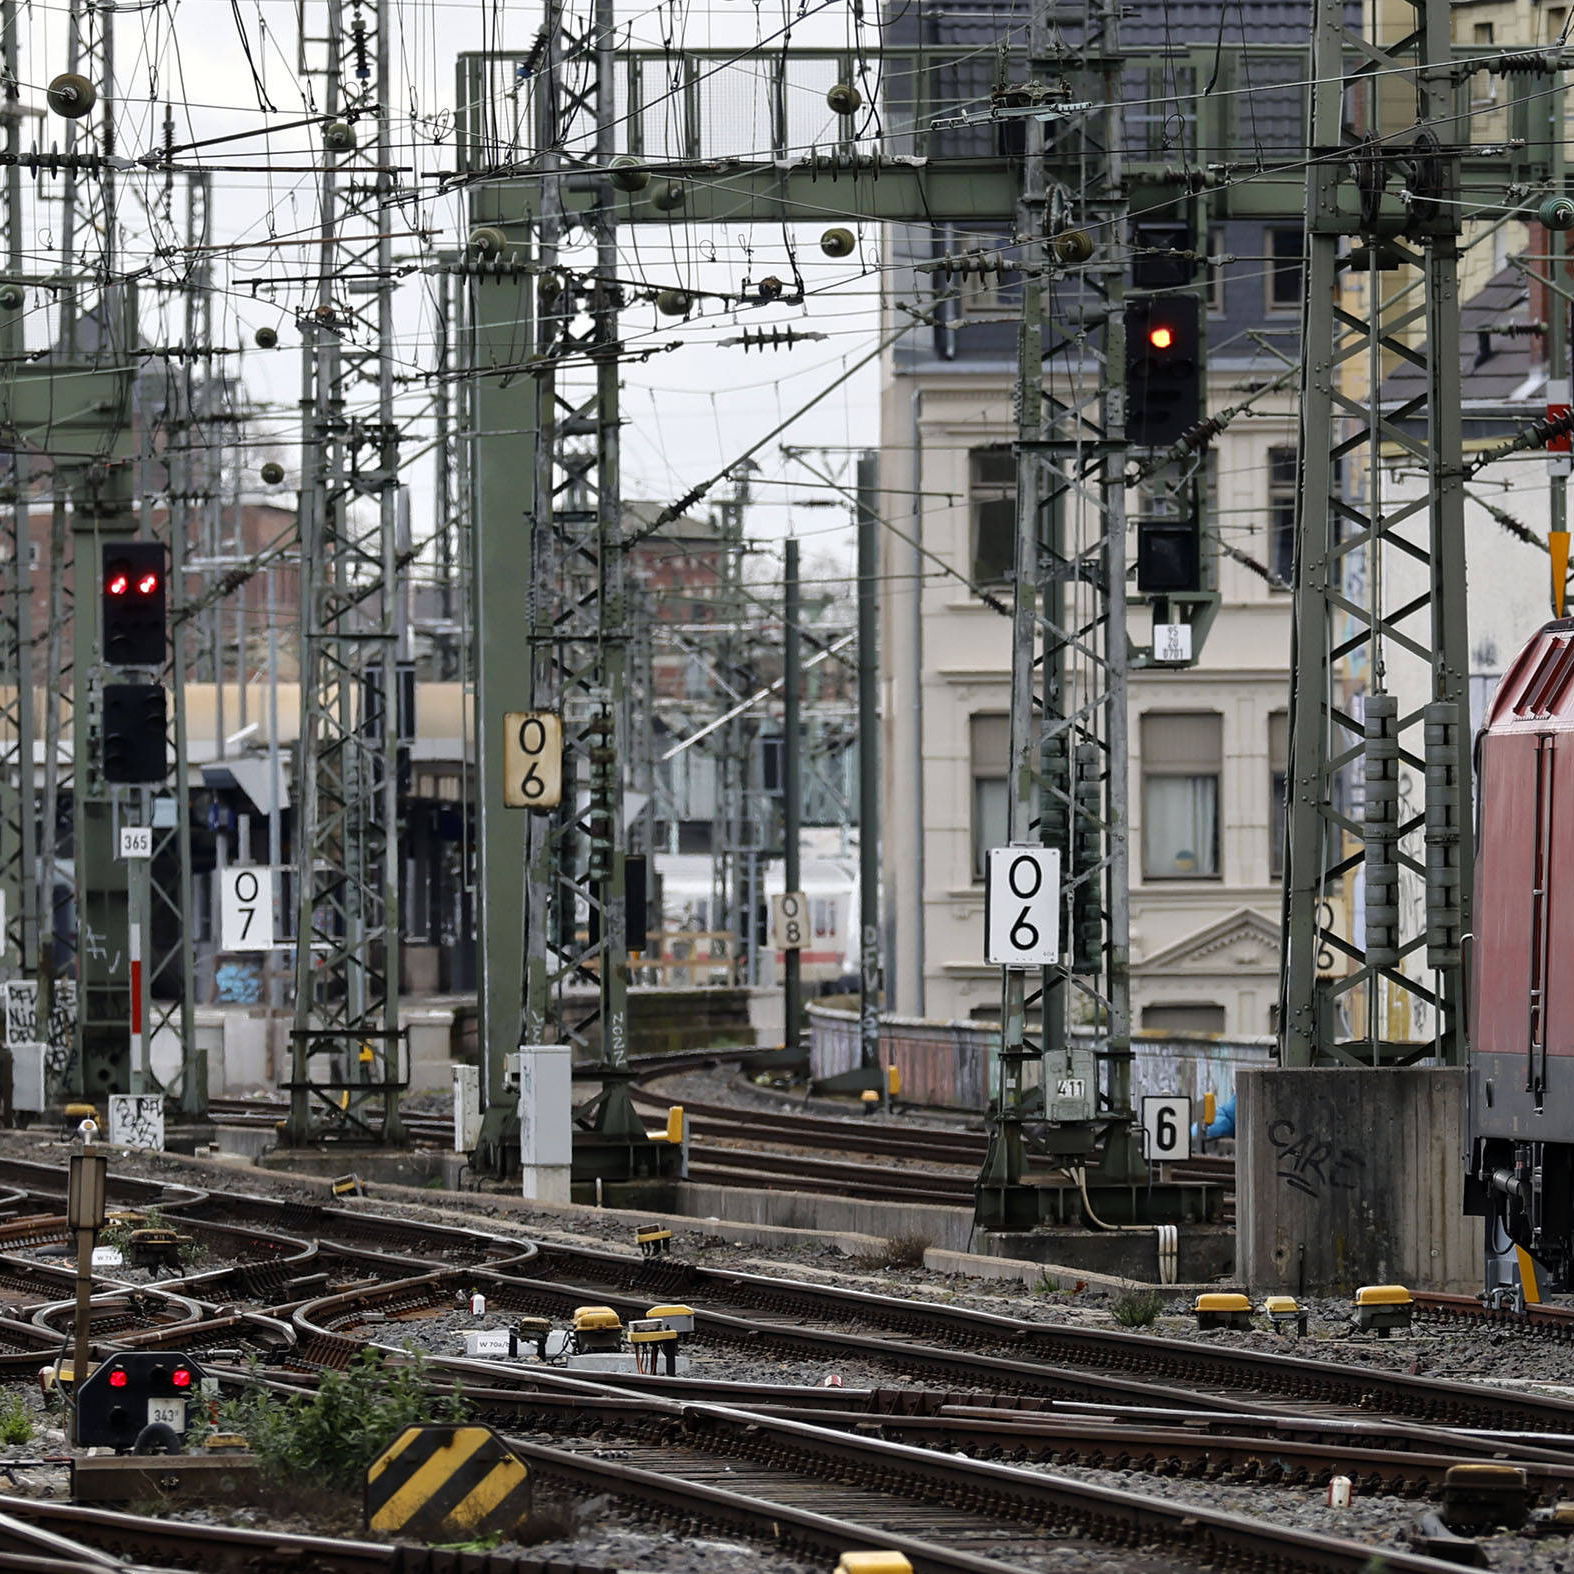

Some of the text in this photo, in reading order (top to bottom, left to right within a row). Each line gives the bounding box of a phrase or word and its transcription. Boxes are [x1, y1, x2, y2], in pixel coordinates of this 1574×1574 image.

[519, 719, 546, 755] 0
[521, 761, 544, 798] 6
[125, 835, 147, 850] 365
[235, 872, 259, 902] 0
[1009, 855, 1042, 899] 0
[782, 897, 799, 917] 0
[238, 908, 255, 940] 7
[786, 920, 800, 943] 8
[1009, 906, 1039, 950] 6
[1057, 1080, 1083, 1096] 411
[1156, 1106, 1177, 1151] 6
